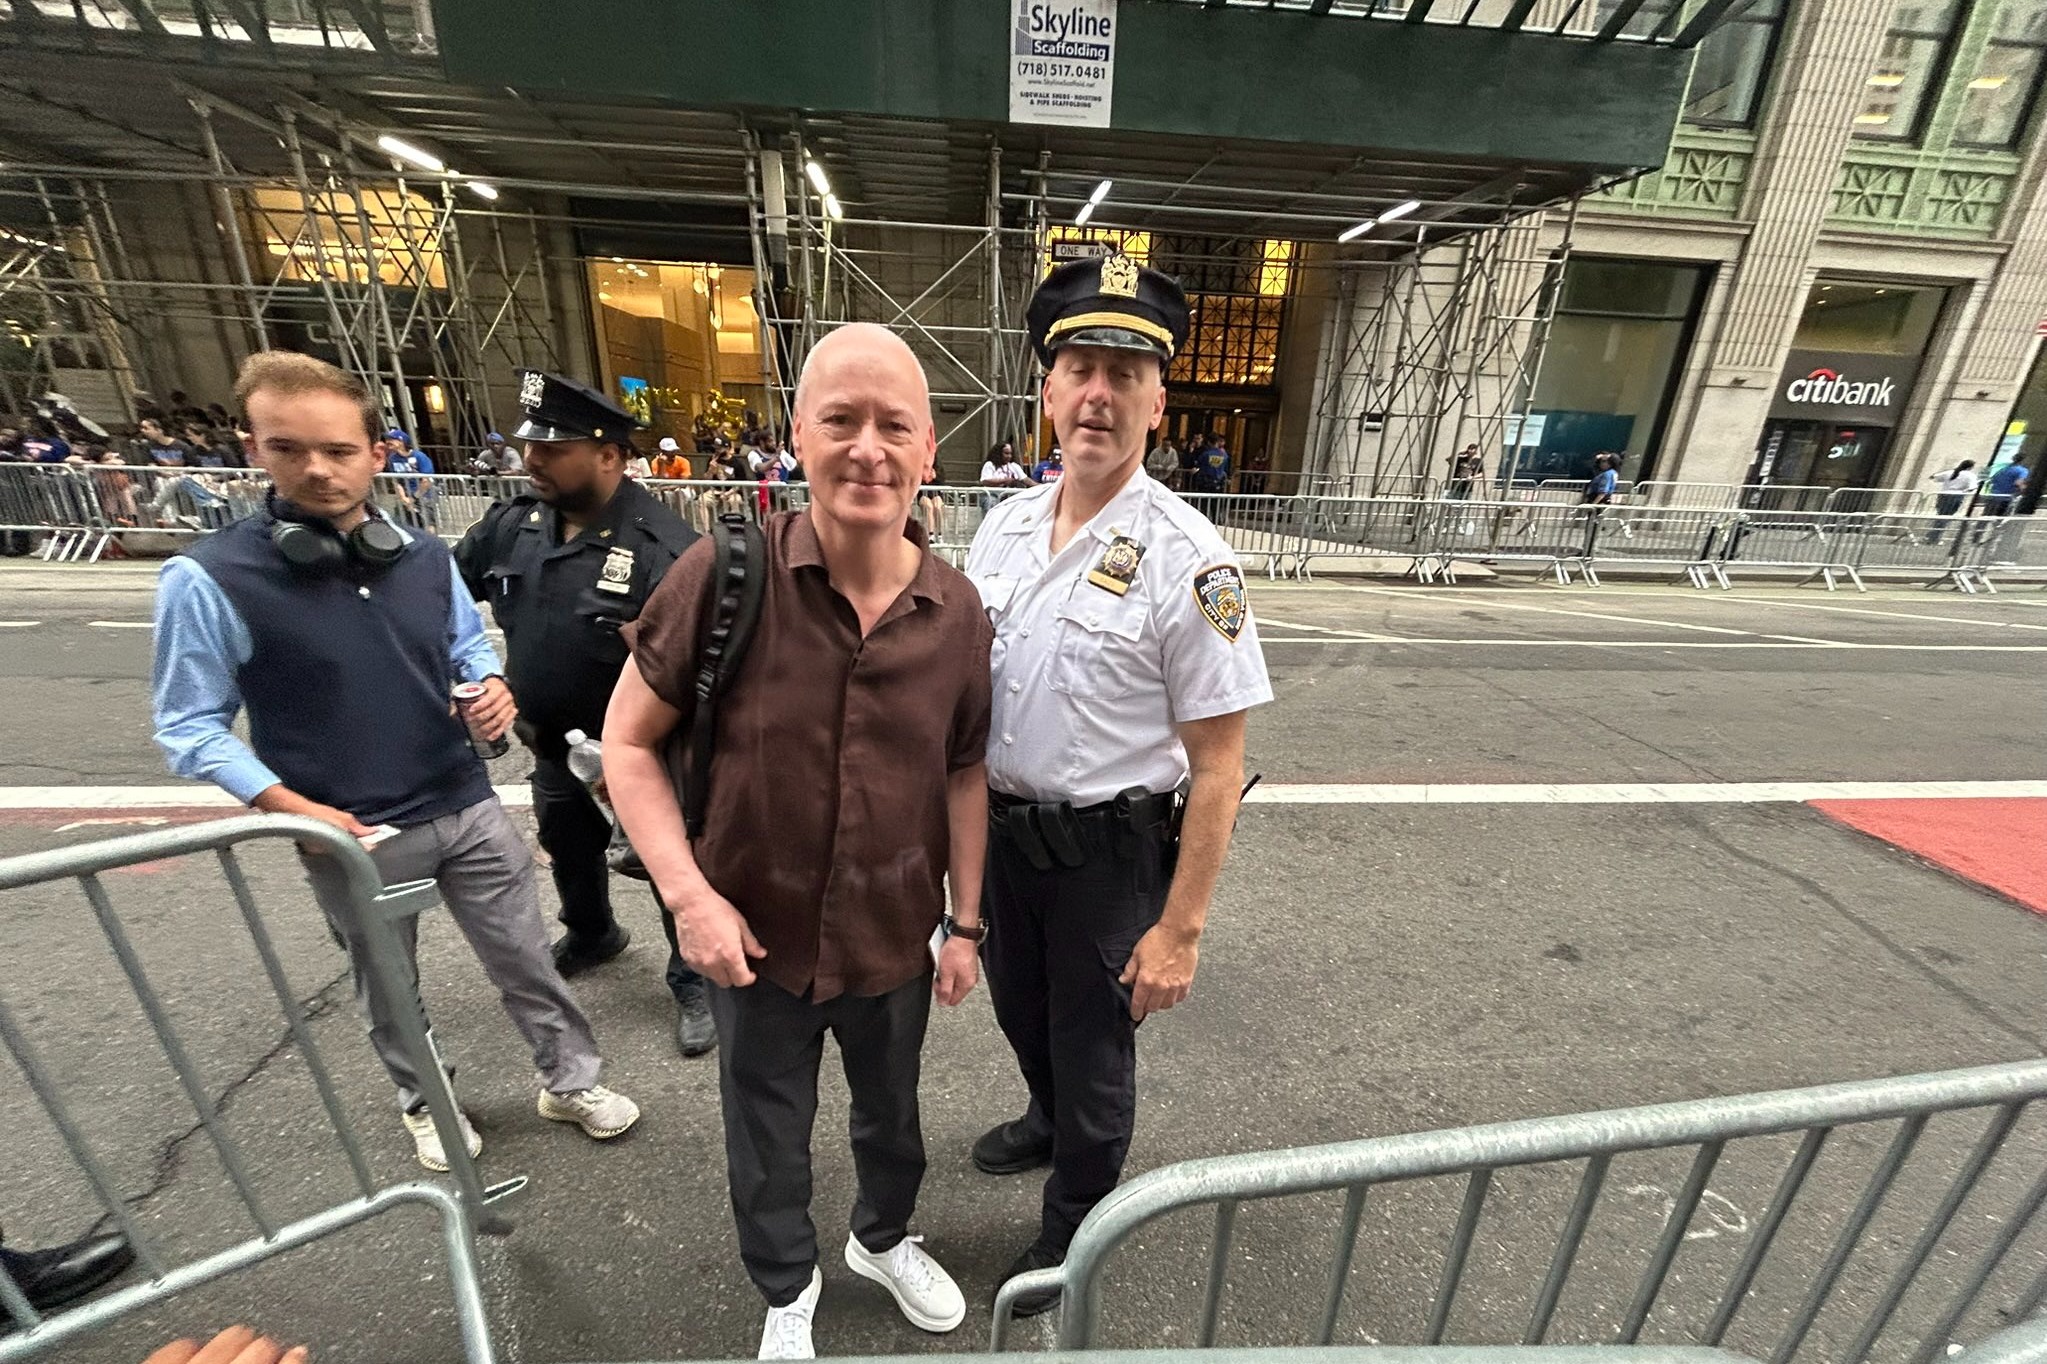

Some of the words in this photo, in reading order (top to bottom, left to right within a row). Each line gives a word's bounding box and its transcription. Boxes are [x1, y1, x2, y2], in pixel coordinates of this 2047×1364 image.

[1031, 4, 1111, 41] Skyline
[1034, 41, 1106, 60] Scaffolding
[1018, 61, 1047, 77] (718)
[1050, 64, 1105, 79] 517.0481
[1020, 91, 1050, 99] SIDEWALK
[1052, 100, 1091, 108] SCAFFOLDING
[1060, 245, 1079, 256] ONE
[1088, 247, 1107, 257] WAY
[1787, 374, 1895, 406] citibank
[1205, 603, 1219, 621] CITY
